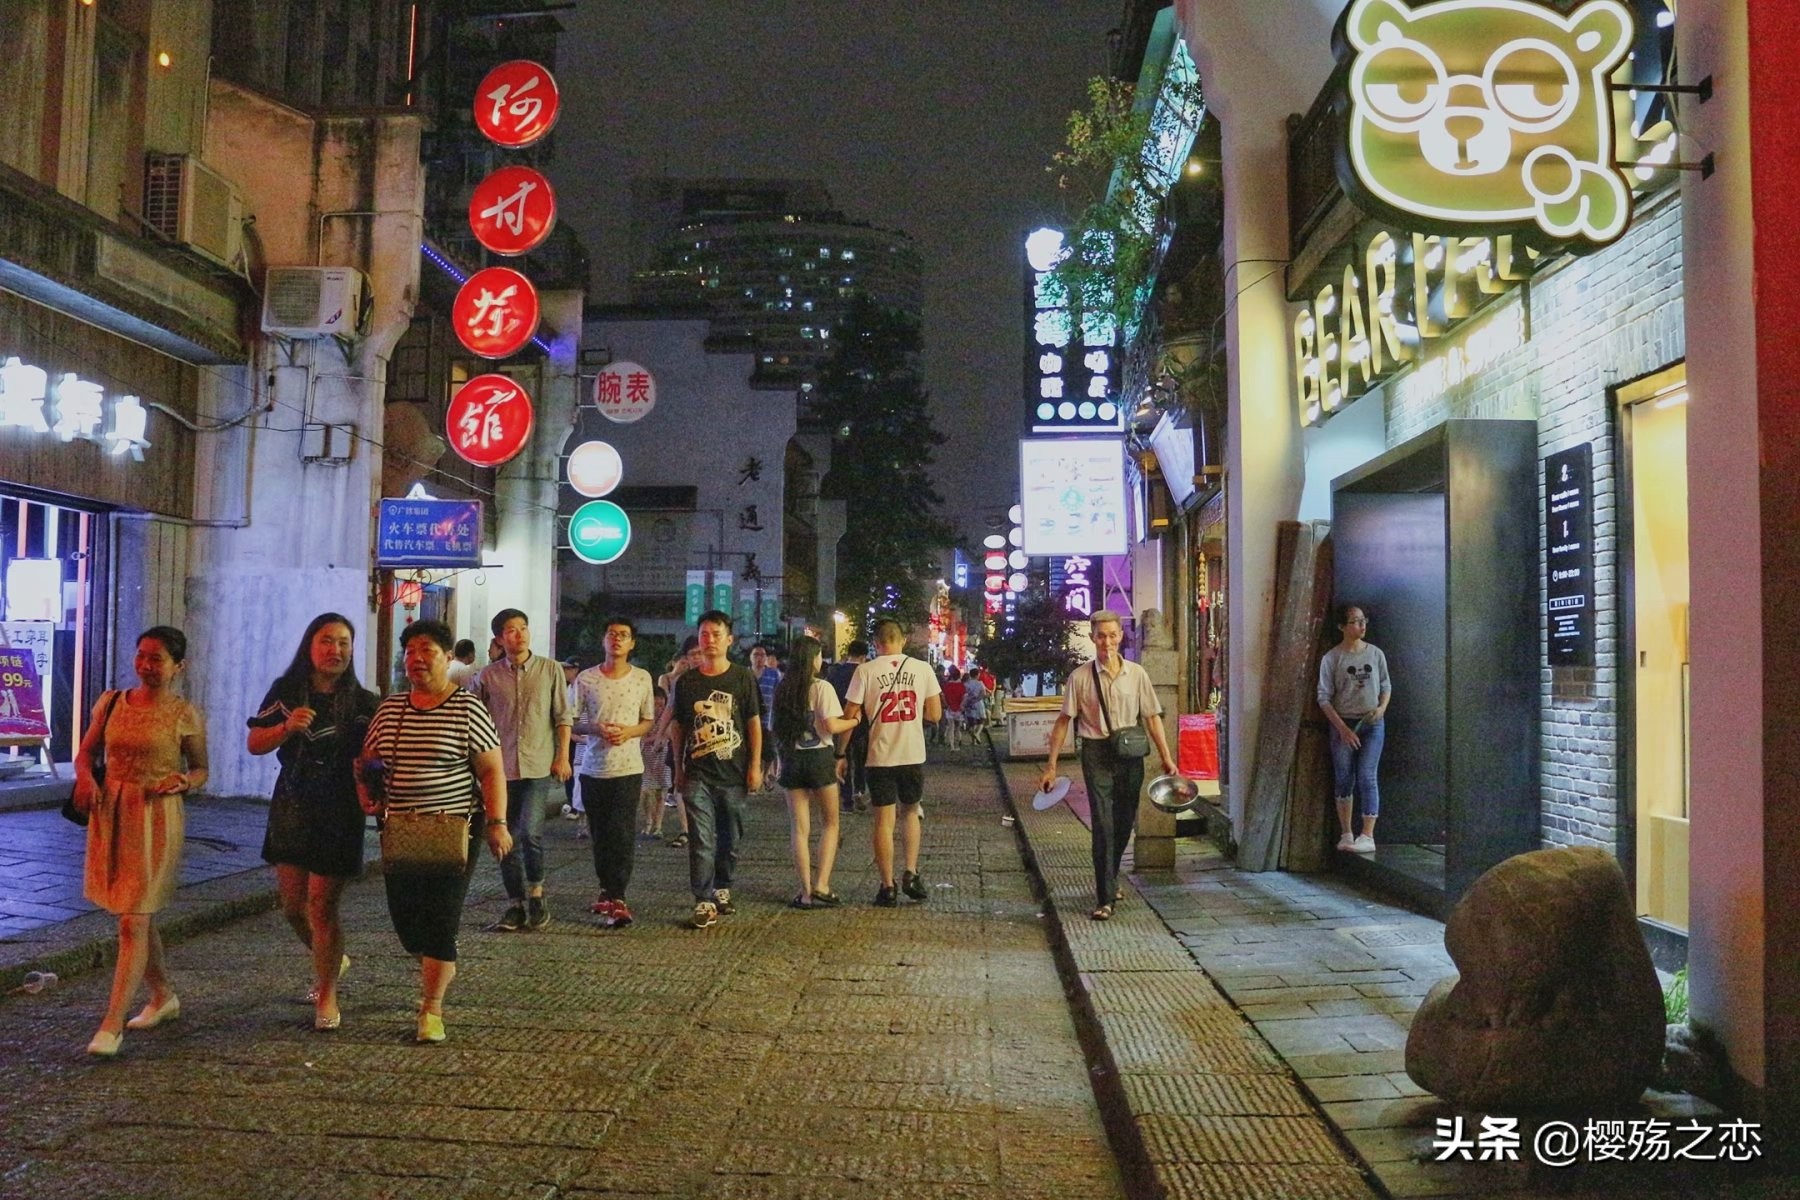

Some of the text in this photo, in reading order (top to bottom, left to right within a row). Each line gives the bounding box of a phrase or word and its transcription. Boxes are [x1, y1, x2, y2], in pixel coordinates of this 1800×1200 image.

[597, 371, 650, 405] 腕表
[388, 522, 471, 537] 火车票代售处
[1063, 555, 1093, 616] 空间
[2, 672, 33, 688] 99元
[876, 671, 917, 689] JORDAN
[879, 690, 918, 723] 23
